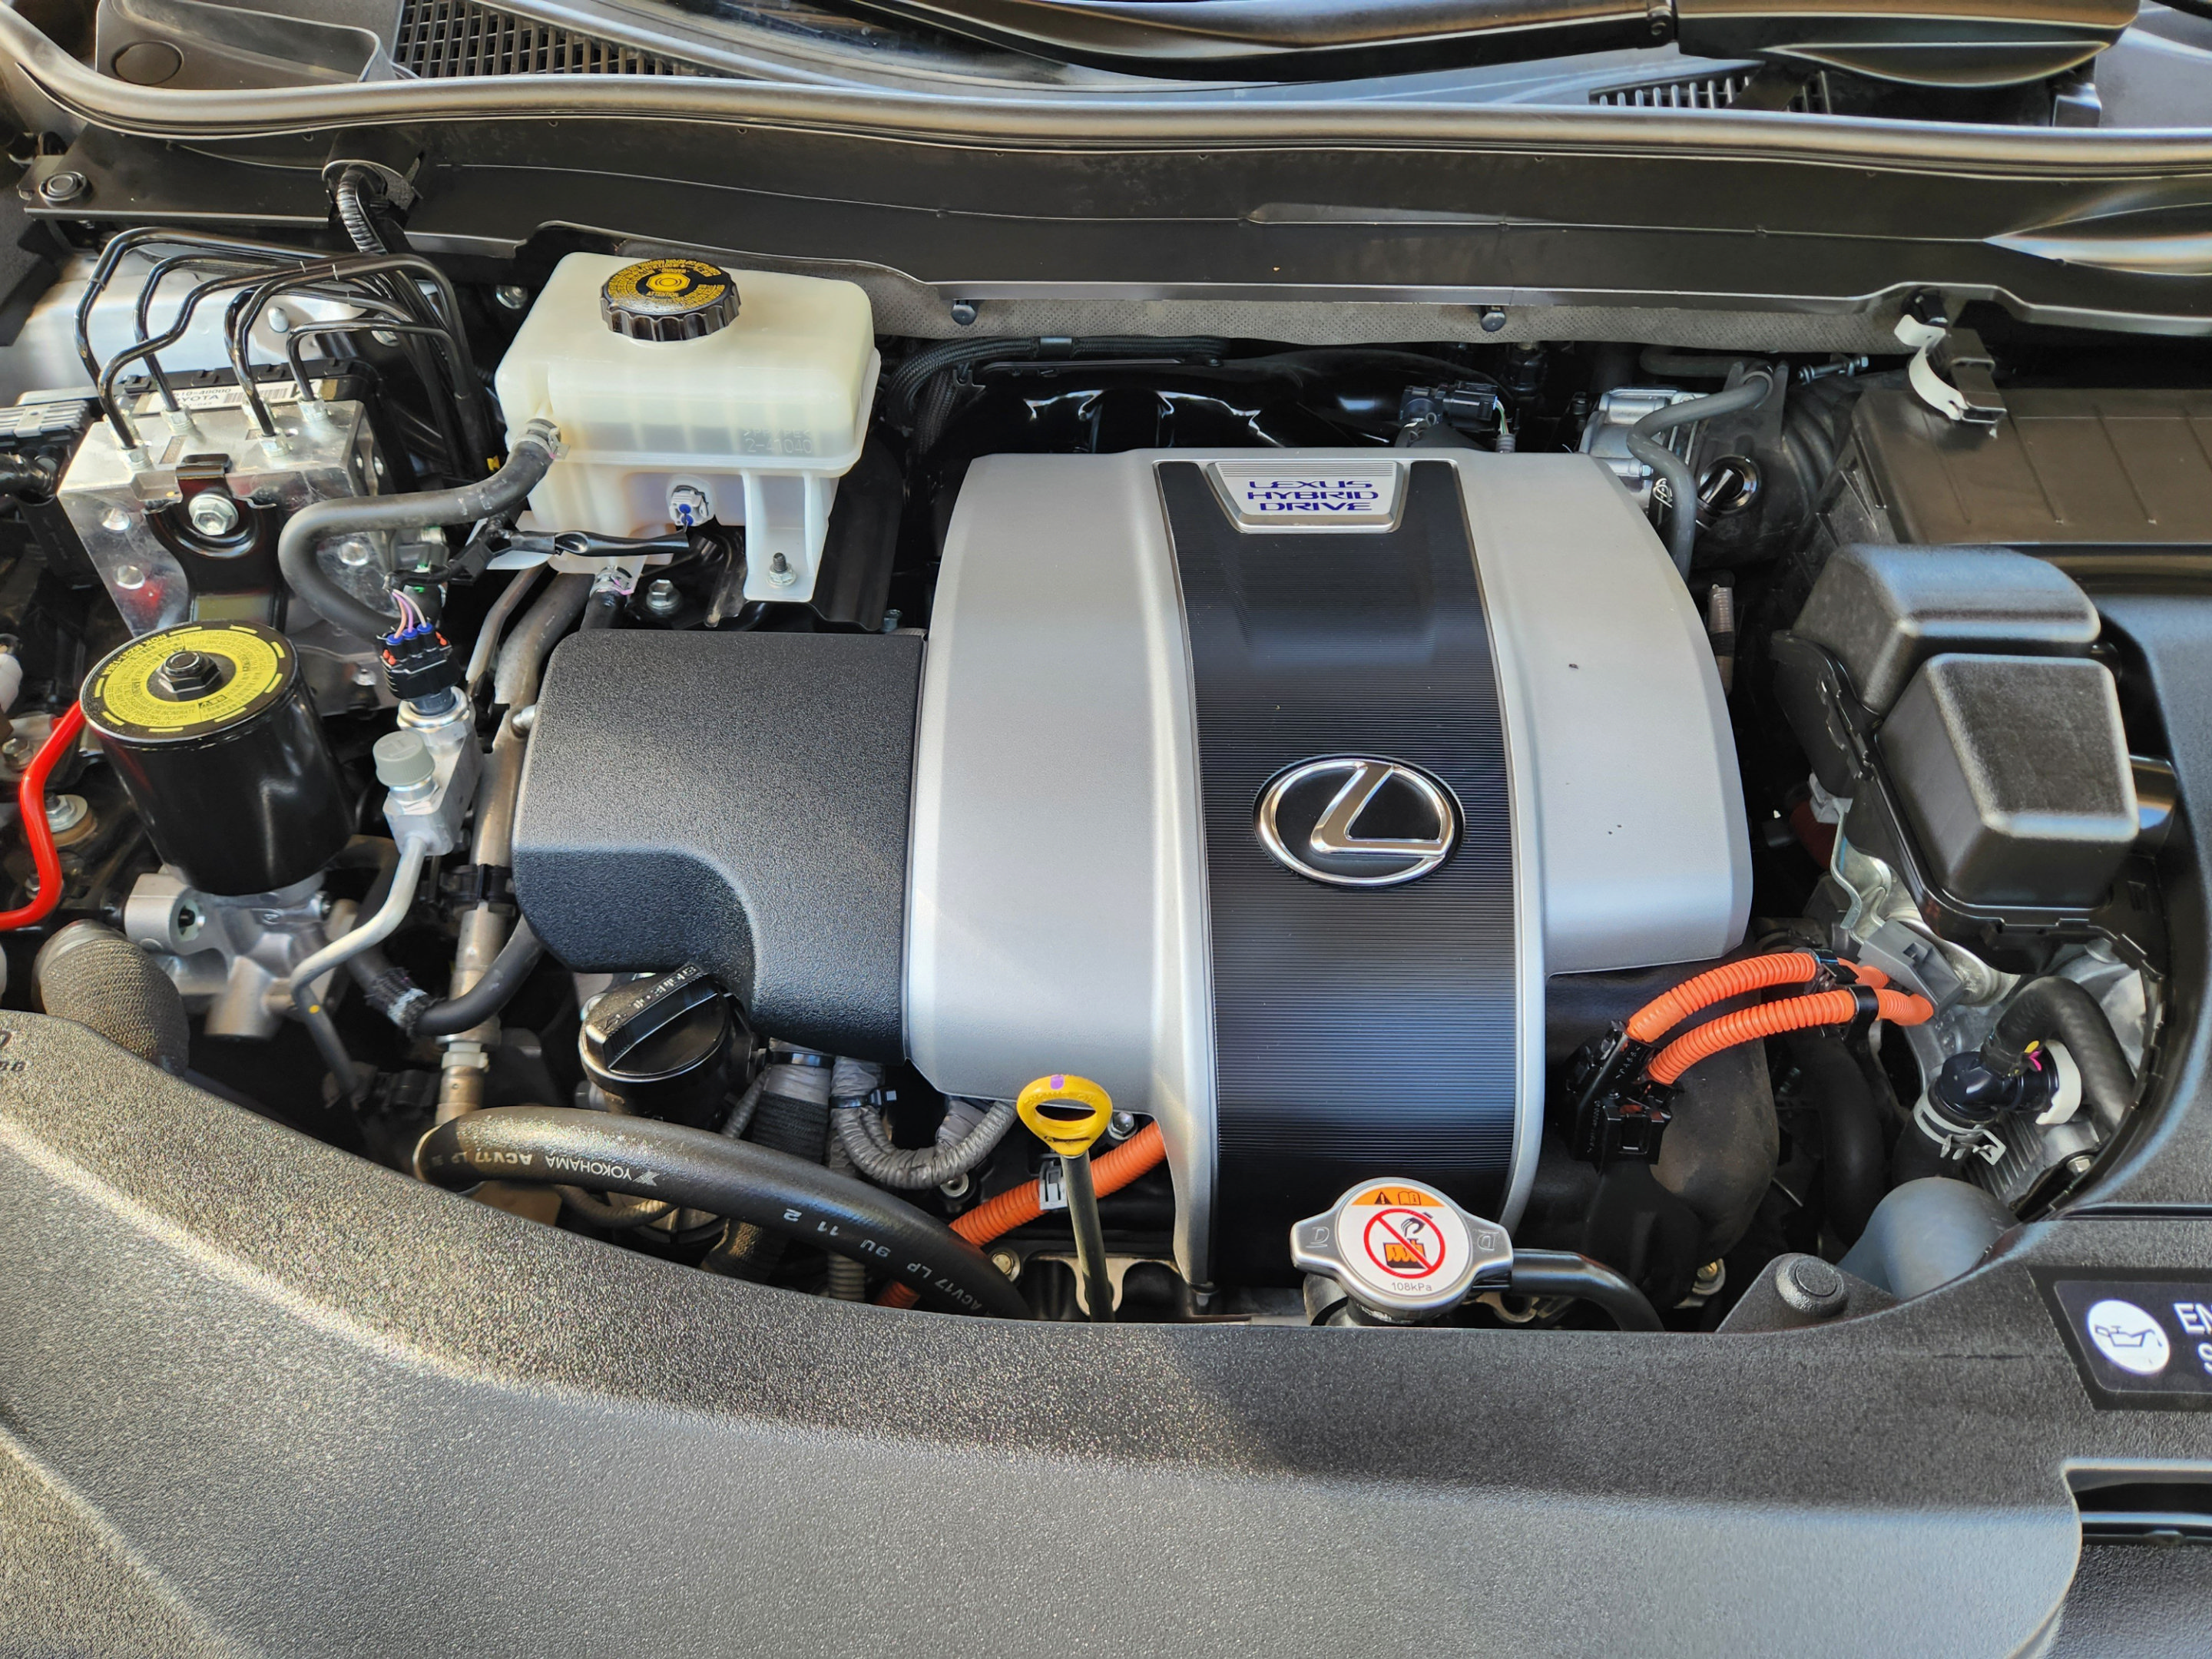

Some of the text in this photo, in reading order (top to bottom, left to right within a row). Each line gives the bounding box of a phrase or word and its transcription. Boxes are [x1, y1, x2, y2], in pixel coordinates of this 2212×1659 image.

[1249, 480, 1373, 488] LEXUS
[1247, 491, 1379, 500] HYBRID
[1259, 502, 1373, 511] DRIVE
[141, 634, 167, 646] NOK
[475, 1151, 533, 1166] ACV17
[546, 1154, 633, 1181] YOKOHAMA
[783, 1208, 803, 1222] 2
[816, 1220, 839, 1237] 11
[906, 1261, 932, 1279] LP
[1391, 1281, 1432, 1292] 108kPa
[934, 1278, 982, 1310] ACV17
